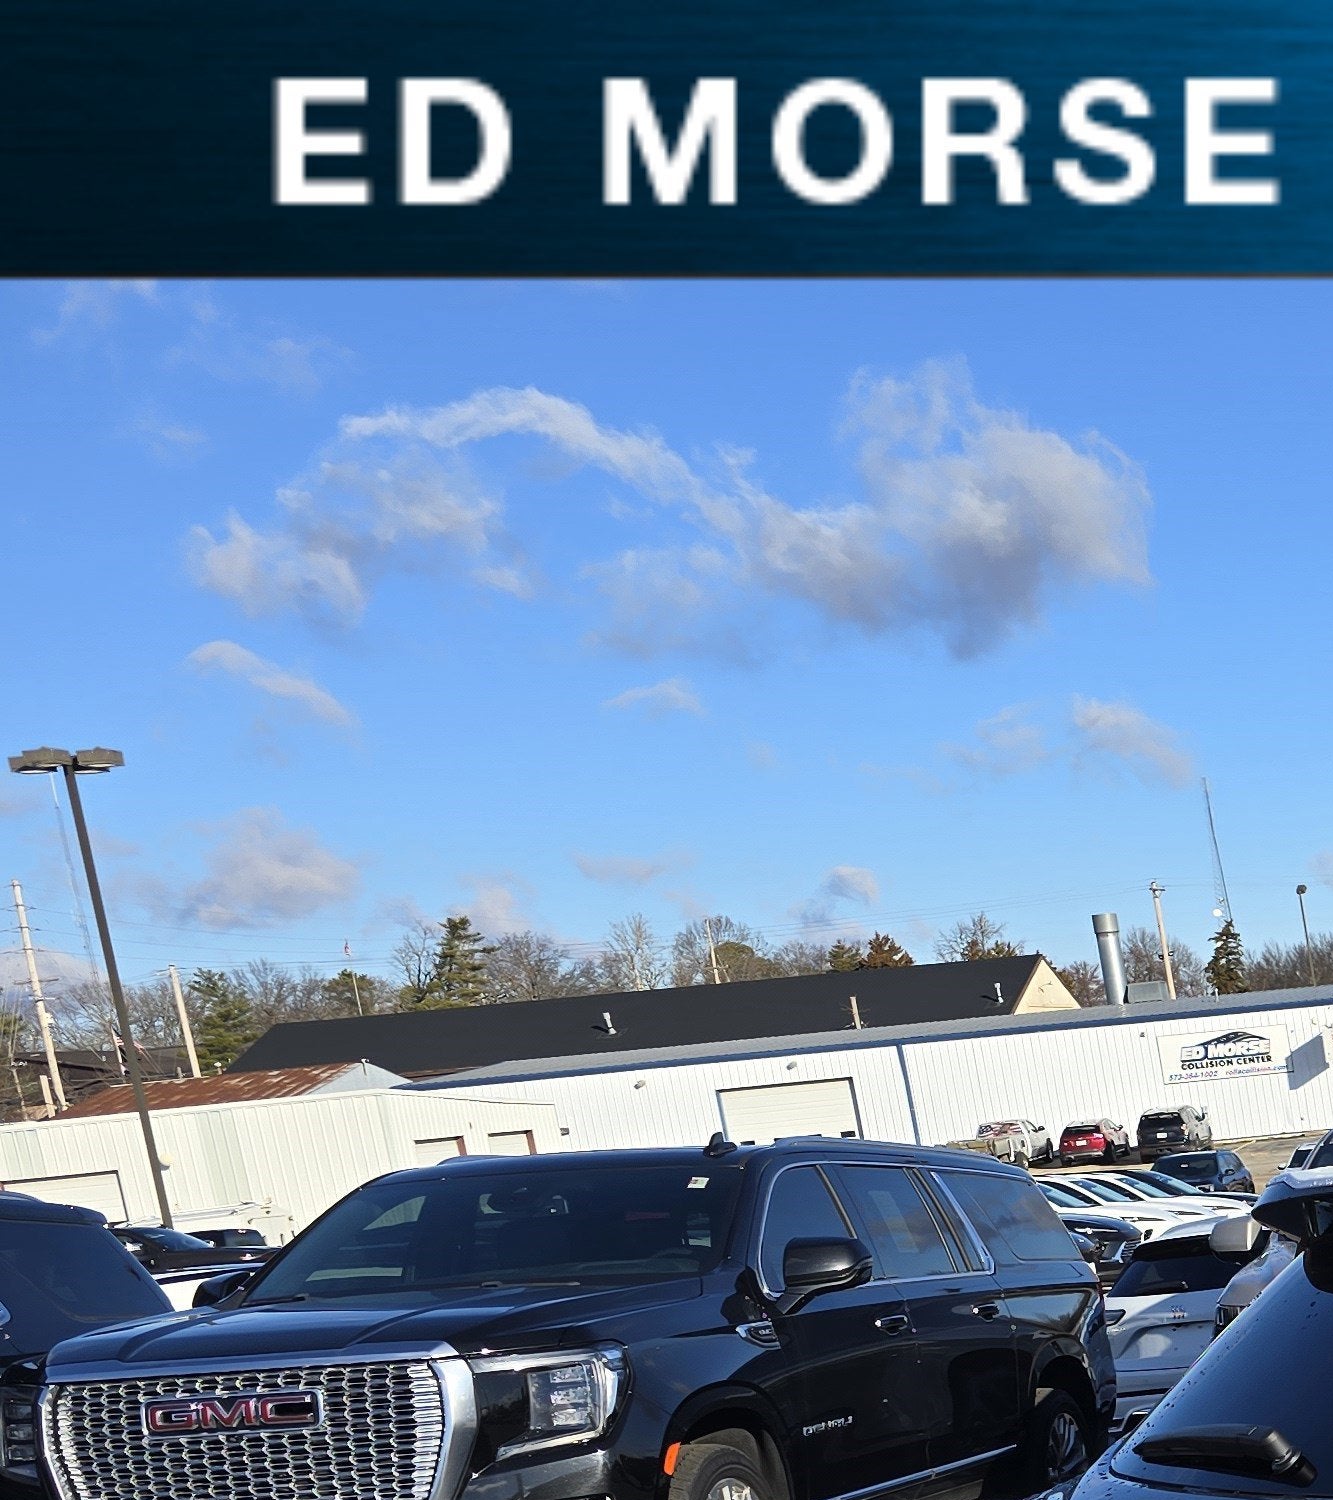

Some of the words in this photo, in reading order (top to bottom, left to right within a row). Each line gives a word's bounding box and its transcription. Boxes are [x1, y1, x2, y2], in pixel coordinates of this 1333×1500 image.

[1180, 1045, 1205, 1062] ED
[1206, 1039, 1270, 1060] MORSE
[1181, 1059, 1234, 1071] COLLISION
[1236, 1055, 1272, 1065] CENTER
[148, 1396, 314, 1432] GMC
